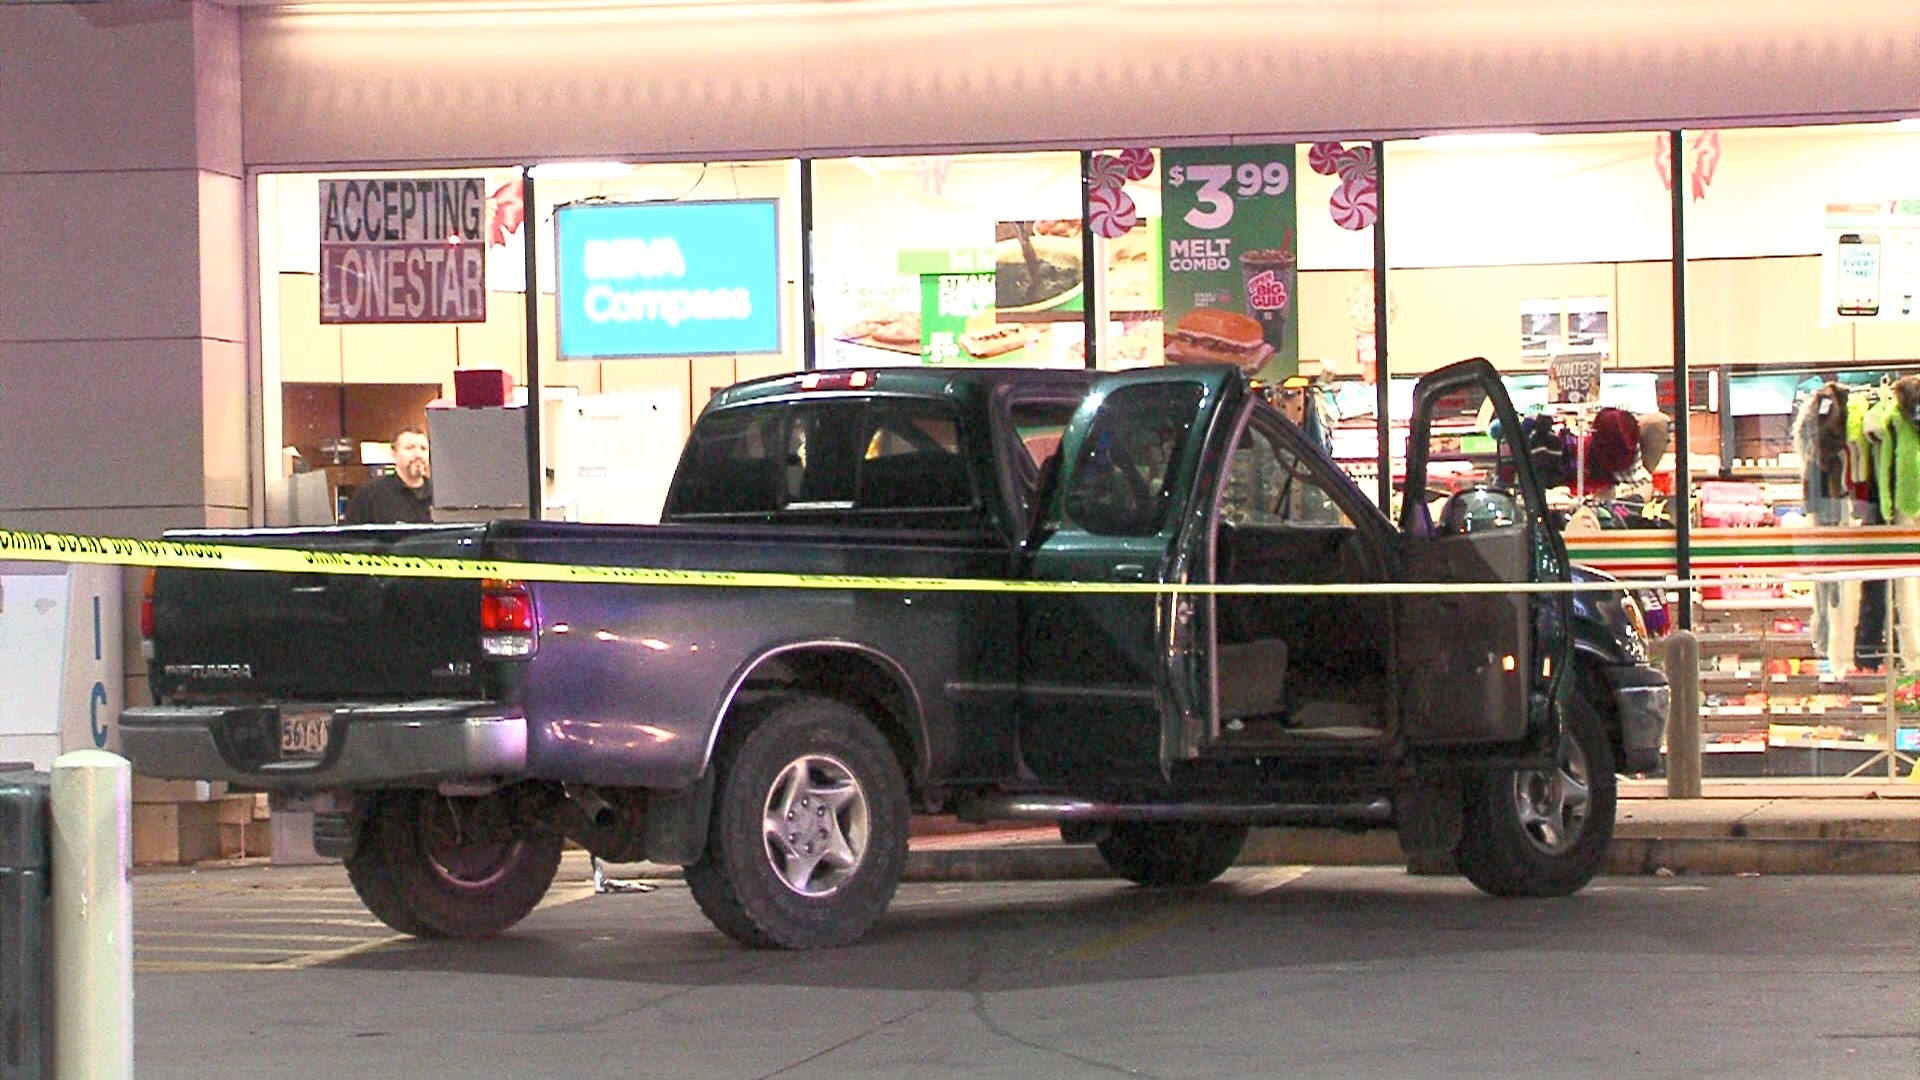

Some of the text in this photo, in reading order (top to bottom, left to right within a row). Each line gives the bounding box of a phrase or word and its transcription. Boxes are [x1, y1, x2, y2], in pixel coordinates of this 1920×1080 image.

[323, 180, 480, 241] ACCEPTING
[1169, 238, 1231, 258] MELT
[1169, 257, 1232, 272] COMBO
[322, 247, 483, 318] LONESTAR
[584, 283, 753, 328] Compass
[1252, 294, 1285, 307] GULP
[1555, 361, 1597, 377] WINTER
[1558, 376, 1590, 391] HATS
